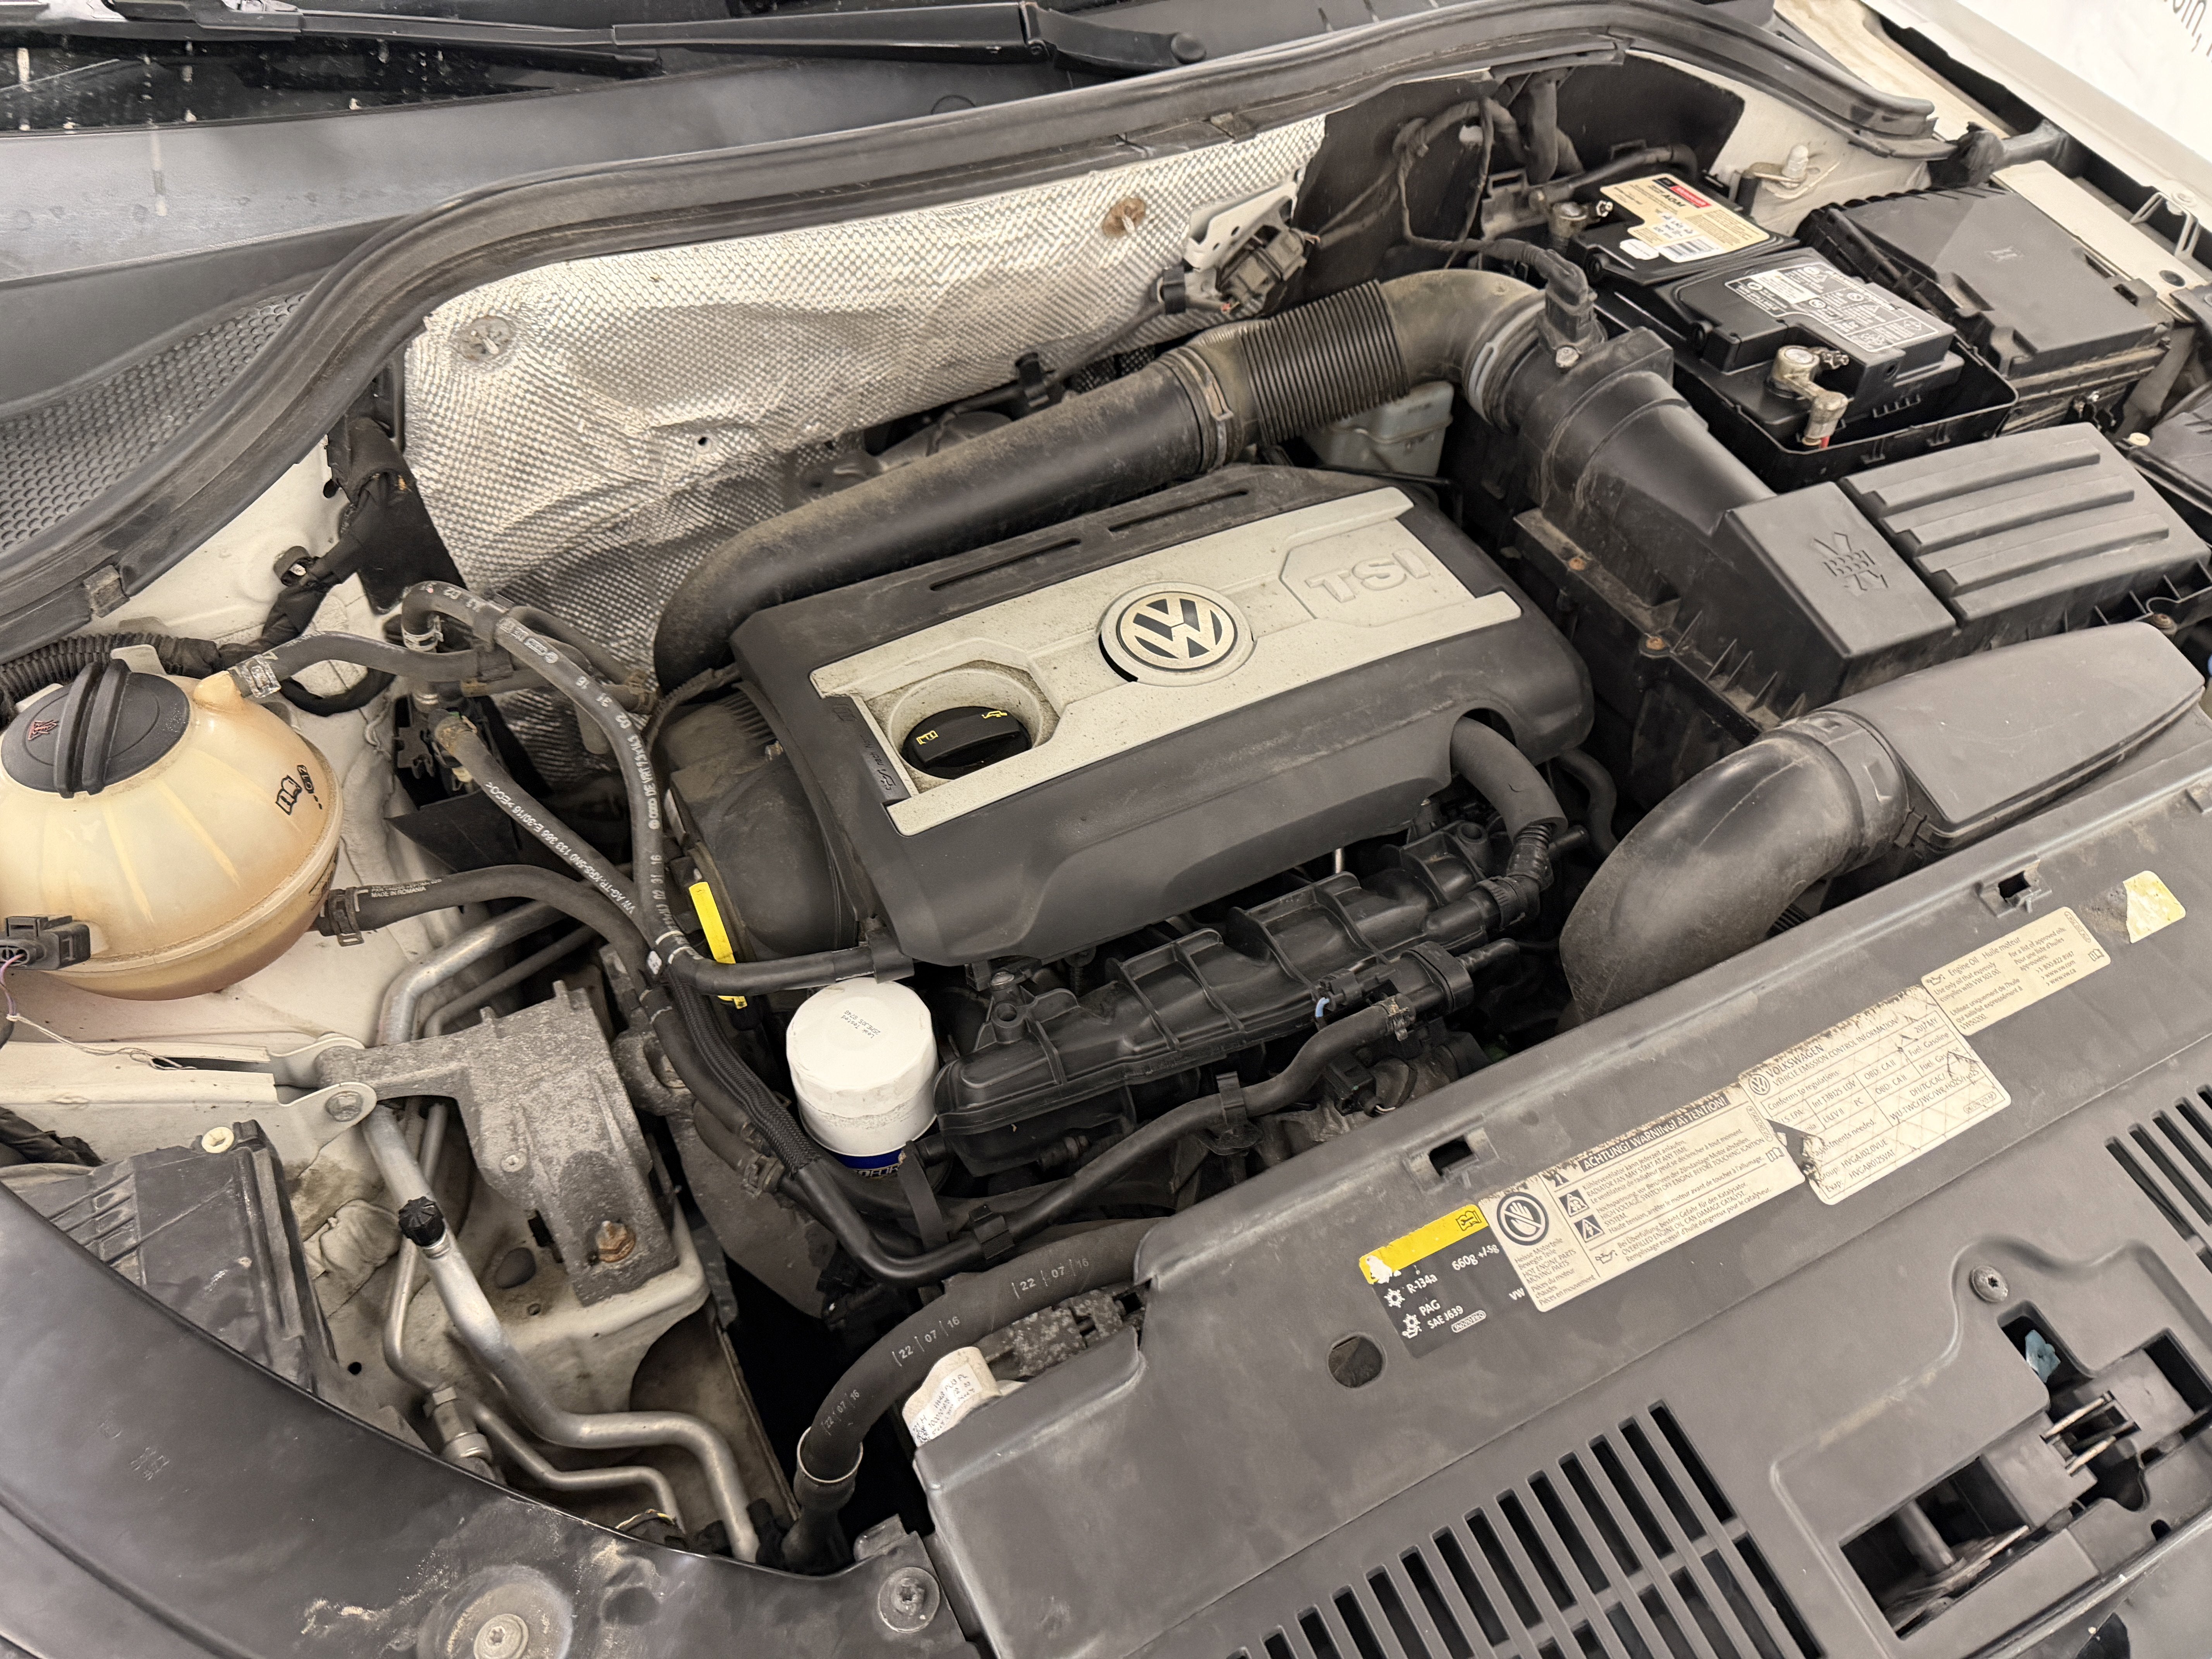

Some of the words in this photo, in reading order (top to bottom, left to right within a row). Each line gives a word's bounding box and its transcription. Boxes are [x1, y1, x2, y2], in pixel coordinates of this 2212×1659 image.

[1307, 548, 1431, 603] TSI
[555, 842, 571, 855] 133
[397, 886, 426, 895] ROMANIA
[2035, 931, 2057, 945] approved
[1948, 963, 1970, 976] Engine
[1968, 956, 1979, 965] Oil
[1982, 948, 1999, 959] Huile
[1999, 937, 2020, 951] moteur
[1944, 982, 1956, 990] only
[1961, 972, 1974, 981] that
[1973, 962, 1996, 975] expressly
[1961, 982, 1974, 991] with
[840, 1015, 860, 1029] Tested
[862, 1028, 874, 1038] Leak
[1765, 1044, 1824, 1077] VOLKSWAGEN
[1768, 1092, 1798, 1110] Conforms
[1805, 1070, 1839, 1091] regulations:
[1913, 1022, 1927, 1033] 2017
[1926, 1017, 1937, 1026] MY
[1772, 1070, 1800, 1086] VEHICLE
[1798, 1054, 1829, 1073] EMISSION
[1828, 1040, 1858, 1057] CONTROL
[1856, 1018, 1898, 1042] INFORMATION
[1843, 1080, 1855, 1091] LDV
[1864, 1068, 1881, 1079] OBD:
[1881, 1062, 1892, 1070] CA
[1908, 1045, 1923, 1056] Fuel:
[1923, 1032, 1949, 1048] Gasoline
[1822, 1110, 1839, 1123] ULEV
[1892, 1077, 1903, 1085] CA
[1851, 1118, 1876, 1135] needed.
[1584, 1143, 1631, 1169] ACHTUNG!
[1630, 1120, 1678, 1146] WARNING!
[1582, 1168, 1625, 1190] Kühlerventilator
[1624, 1162, 1639, 1171] kann
[1586, 1181, 1614, 1197] RADIATOR
[1613, 1175, 1626, 1184] FAN
[1624, 1169, 1637, 1178] MAY
[1637, 1161, 1654, 1173] START
[1654, 1157, 1661, 1165] AT
[1662, 1152, 1673, 1161] ANY
[1597, 1184, 1626, 1200] ventilateur
[1633, 1169, 1657, 1183] radiateur
[1658, 1162, 1672, 1174] peut
[1708, 1139, 1721, 1147] tout
[1600, 1209, 1616, 1220] HIGH
[1640, 1187, 1662, 1200] SWITCH
[1662, 1182, 1672, 1190] OFF
[1672, 1172, 1693, 1185] ENGINE
[1693, 1162, 1713, 1175] BEFORE
[1712, 1149, 1740, 1166] TOUCHING
[1740, 1137, 1765, 1152] IGNITION
[1645, 1175, 1671, 1190] Berühren
[1679, 1157, 1711, 1176] Zündanlage
[1708, 1149, 1726, 1159] Motor
[1825, 1180, 1843, 1192] Evap:
[1608, 1223, 1626, 1233] Haute
[1625, 1213, 1648, 1225] tension,
[1647, 1203, 1665, 1215] arrêter
[1671, 1191, 1690, 1203] moteur
[1690, 1183, 1705, 1194] avant
[1712, 1170, 1732, 1183] toucher
[1617, 1240, 1627, 1248] Bei
[1658, 1214, 1680, 1228] besteht
[1679, 1206, 1697, 1218] Gefahr
[1621, 1236, 1653, 1255] OVERFILLED
[1652, 1226, 1674, 1240] ENGINE
[1684, 1214, 1697, 1224] CAN
[1696, 1203, 1720, 1218] DAMAGE
[1625, 1243, 1659, 1262] Remplissage
[1656, 1231, 1680, 1247] excessif
[1681, 1223, 1698, 1235] d'huile
[1698, 1209, 1726, 1226] dangereux
[1726, 1203, 1738, 1213] pour
[1514, 1252, 1533, 1264] Heisse
[1533, 1238, 1563, 1254] Motorteile
[1518, 1256, 1540, 1270] Bewegte
[1539, 1249, 1557, 1260] Teile
[1522, 1267, 1535, 1278] HOT
[1535, 1257, 1559, 1272] ENGINE
[1558, 1249, 1576, 1260] PARTS
[1020, 1278, 1036, 1290] 22
[1051, 1266, 1064, 1278] 07
[1075, 1258, 1089, 1268] 16
[1406, 1274, 1437, 1293] R-134a
[1451, 1254, 1478, 1270] 660g
[1526, 1268, 1552, 1284] MOVING
[1551, 1259, 1570, 1272] PARTS
[1555, 1268, 1575, 1281] moteur
[1563, 1274, 1595, 1293] mouvement
[1508, 1288, 1525, 1300] VW
[1535, 1286, 1558, 1298] chaudes
[1419, 1299, 1440, 1316] PAG
[1427, 1315, 1445, 1329] SAE
[1444, 1305, 1463, 1321] J639
[898, 1345, 913, 1358] 22
[924, 1329, 936, 1342] 07
[947, 1316, 960, 1328] 16
